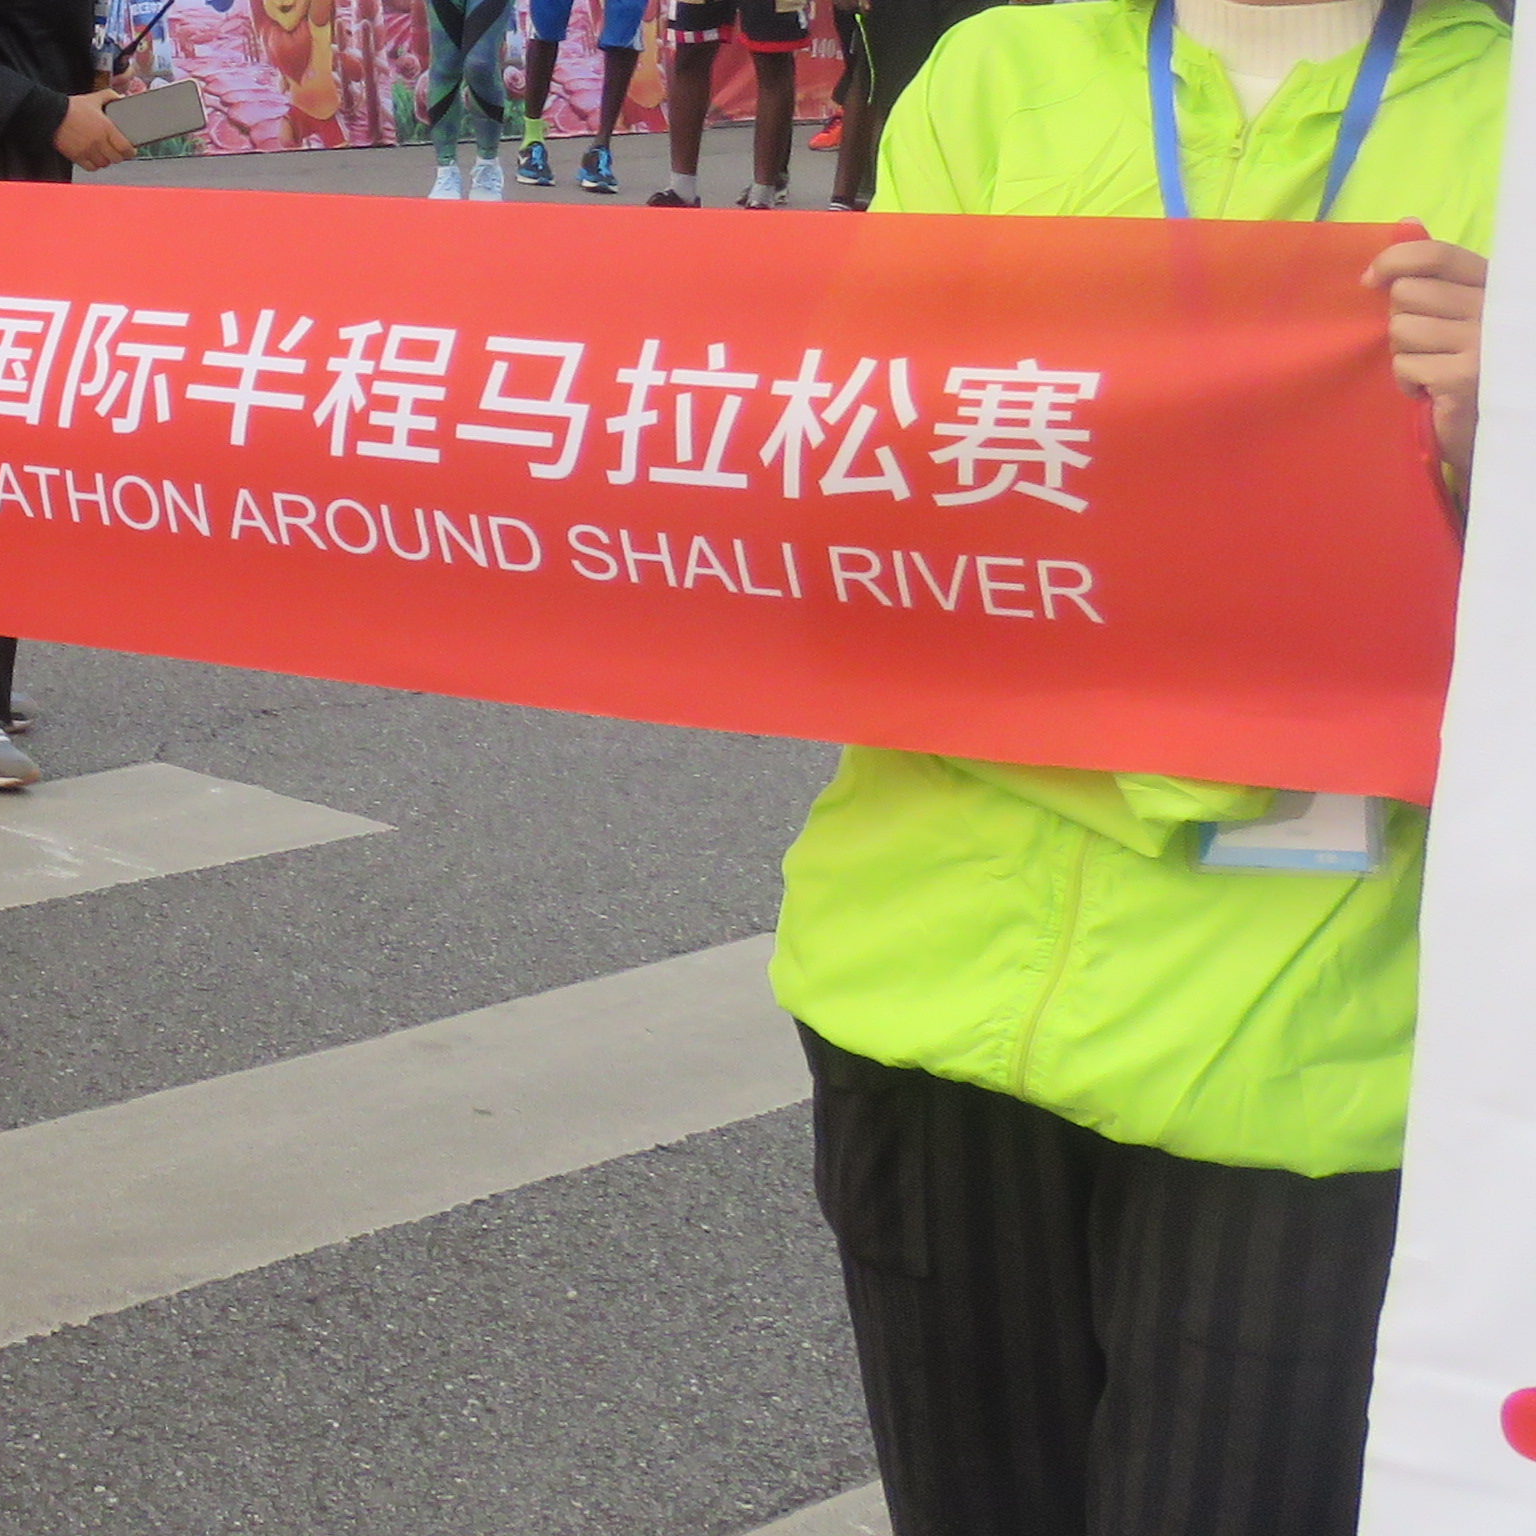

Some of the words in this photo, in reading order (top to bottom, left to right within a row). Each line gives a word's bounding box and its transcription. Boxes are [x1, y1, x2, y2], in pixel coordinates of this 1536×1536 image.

[230, 488, 542, 572] AROUND
[567, 524, 802, 598] SHALI
[828, 546, 1103, 623] RIVER
